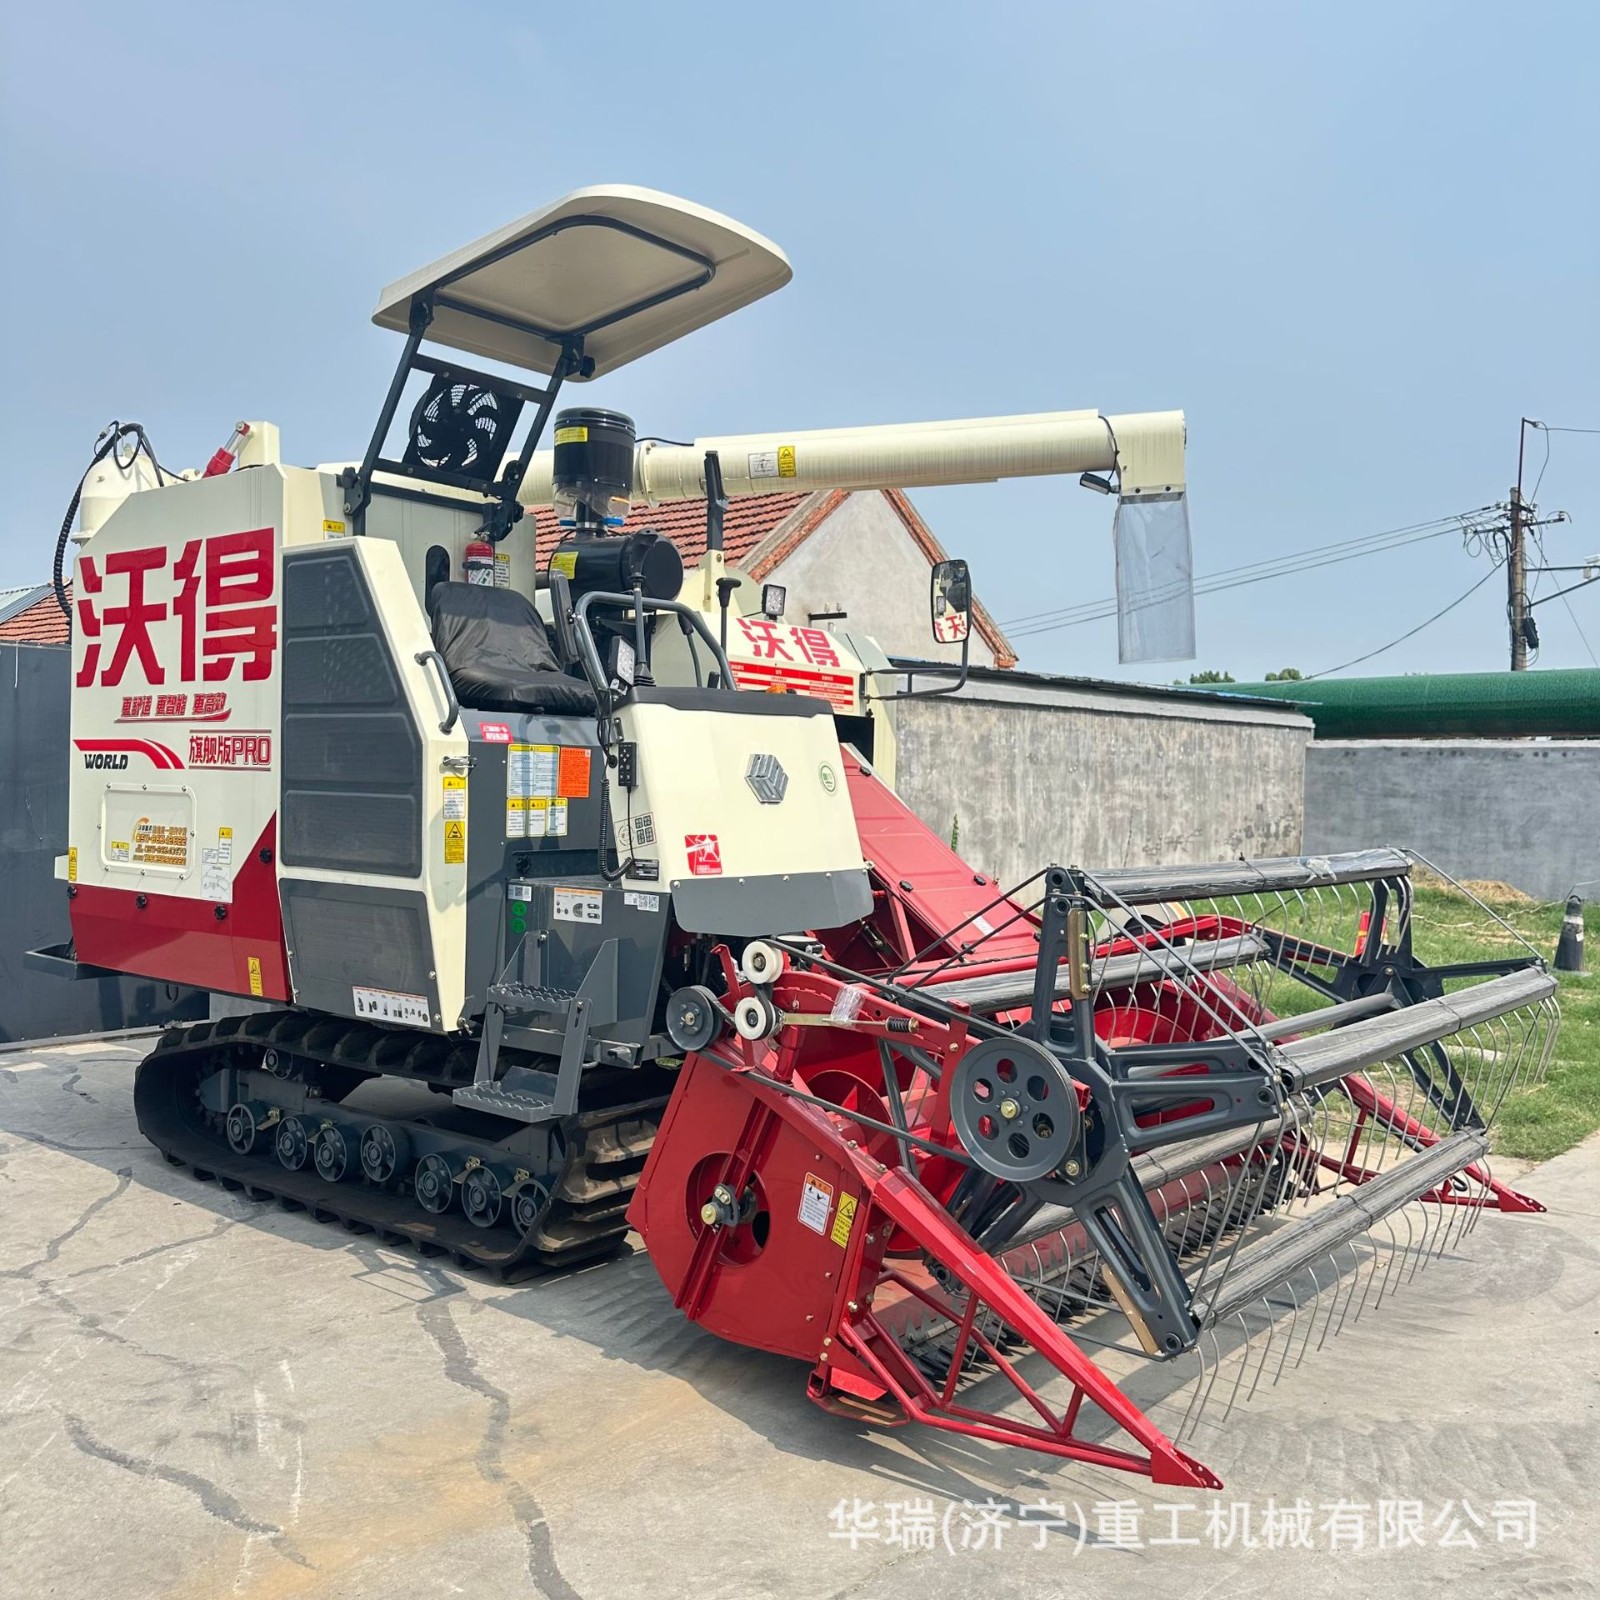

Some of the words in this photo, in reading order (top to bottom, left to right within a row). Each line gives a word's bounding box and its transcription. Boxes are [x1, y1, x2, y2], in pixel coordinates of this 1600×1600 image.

[76, 527, 277, 688] 沃得
[736, 617, 841, 668] 沃得
[121, 695, 153, 717] 更舒适
[155, 693, 188, 716] 更智能
[192, 691, 227, 715] 更高效
[84, 753, 129, 770] WORLD
[189, 735, 272, 766] 旗舰版PRO
